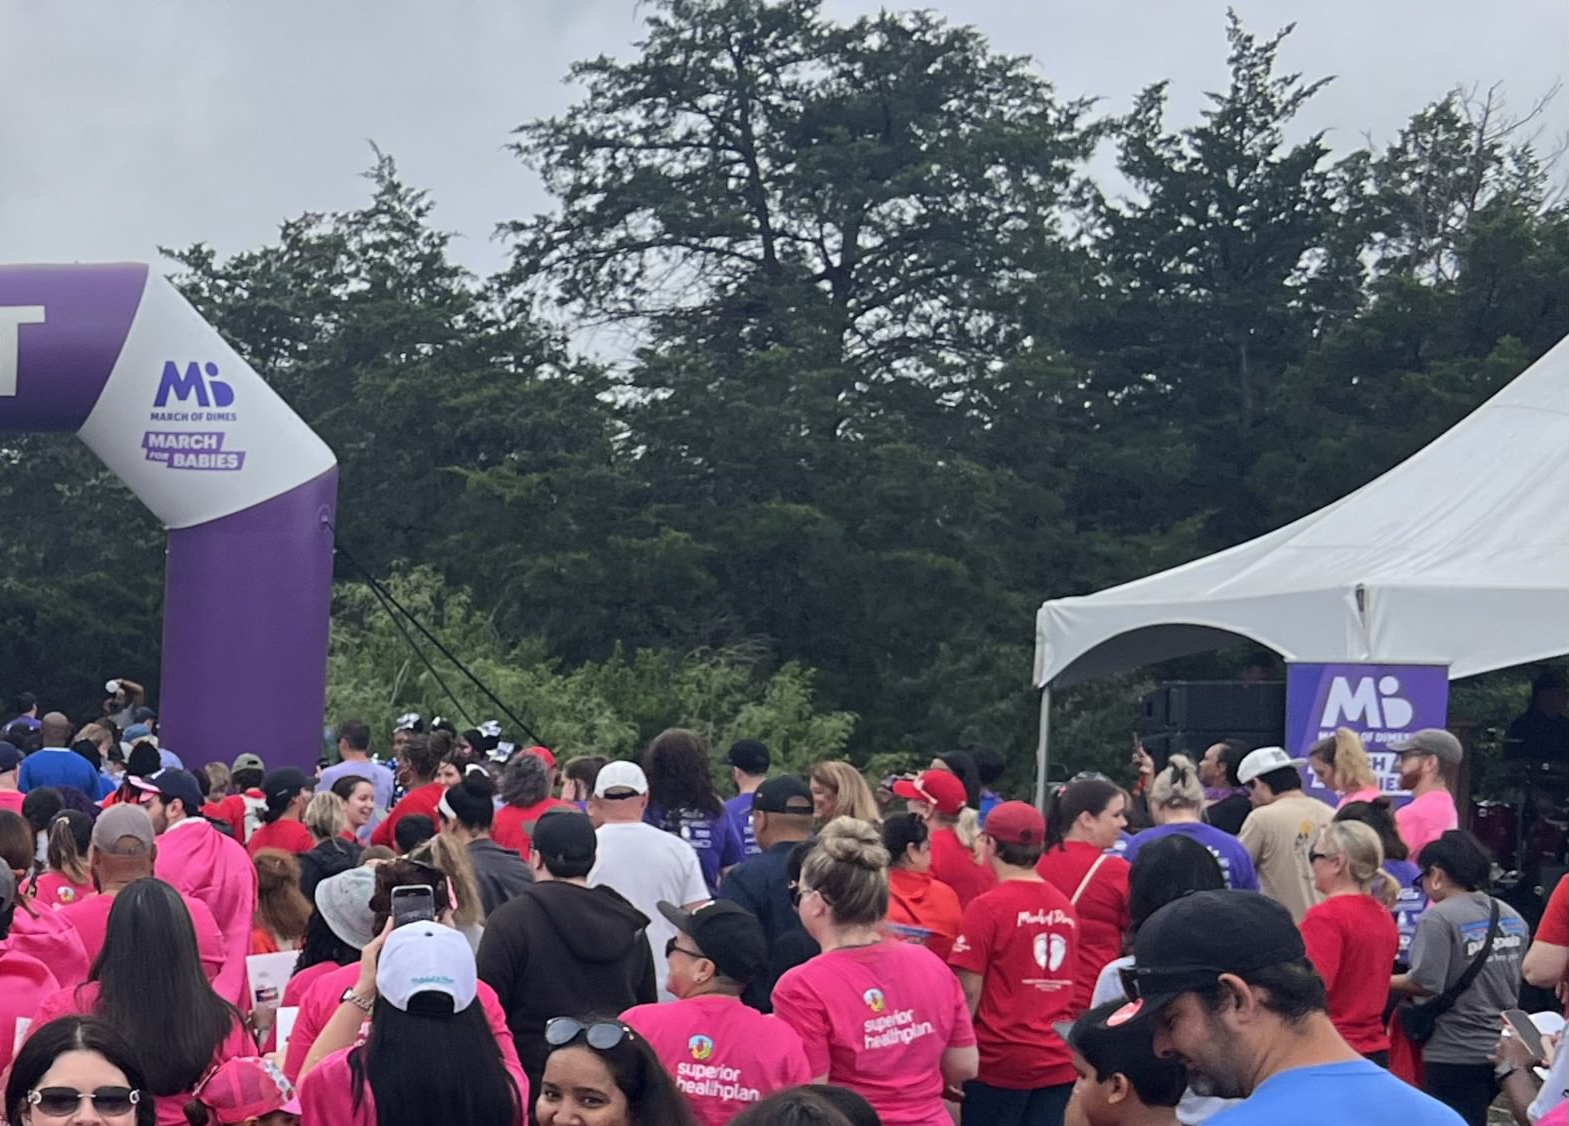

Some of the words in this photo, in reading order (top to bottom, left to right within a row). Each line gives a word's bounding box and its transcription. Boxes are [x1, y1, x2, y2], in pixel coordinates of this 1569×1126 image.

[150, 412, 189, 421] MARCH
[190, 412, 204, 421] OF
[206, 412, 237, 421] DIMES
[148, 434, 217, 449] MARCH
[173, 453, 239, 468] BABIES
[864, 1009, 914, 1033] superior
[864, 1021, 932, 1050] healthplan
[677, 1062, 741, 1082] superior
[676, 1076, 760, 1102] healthplan
